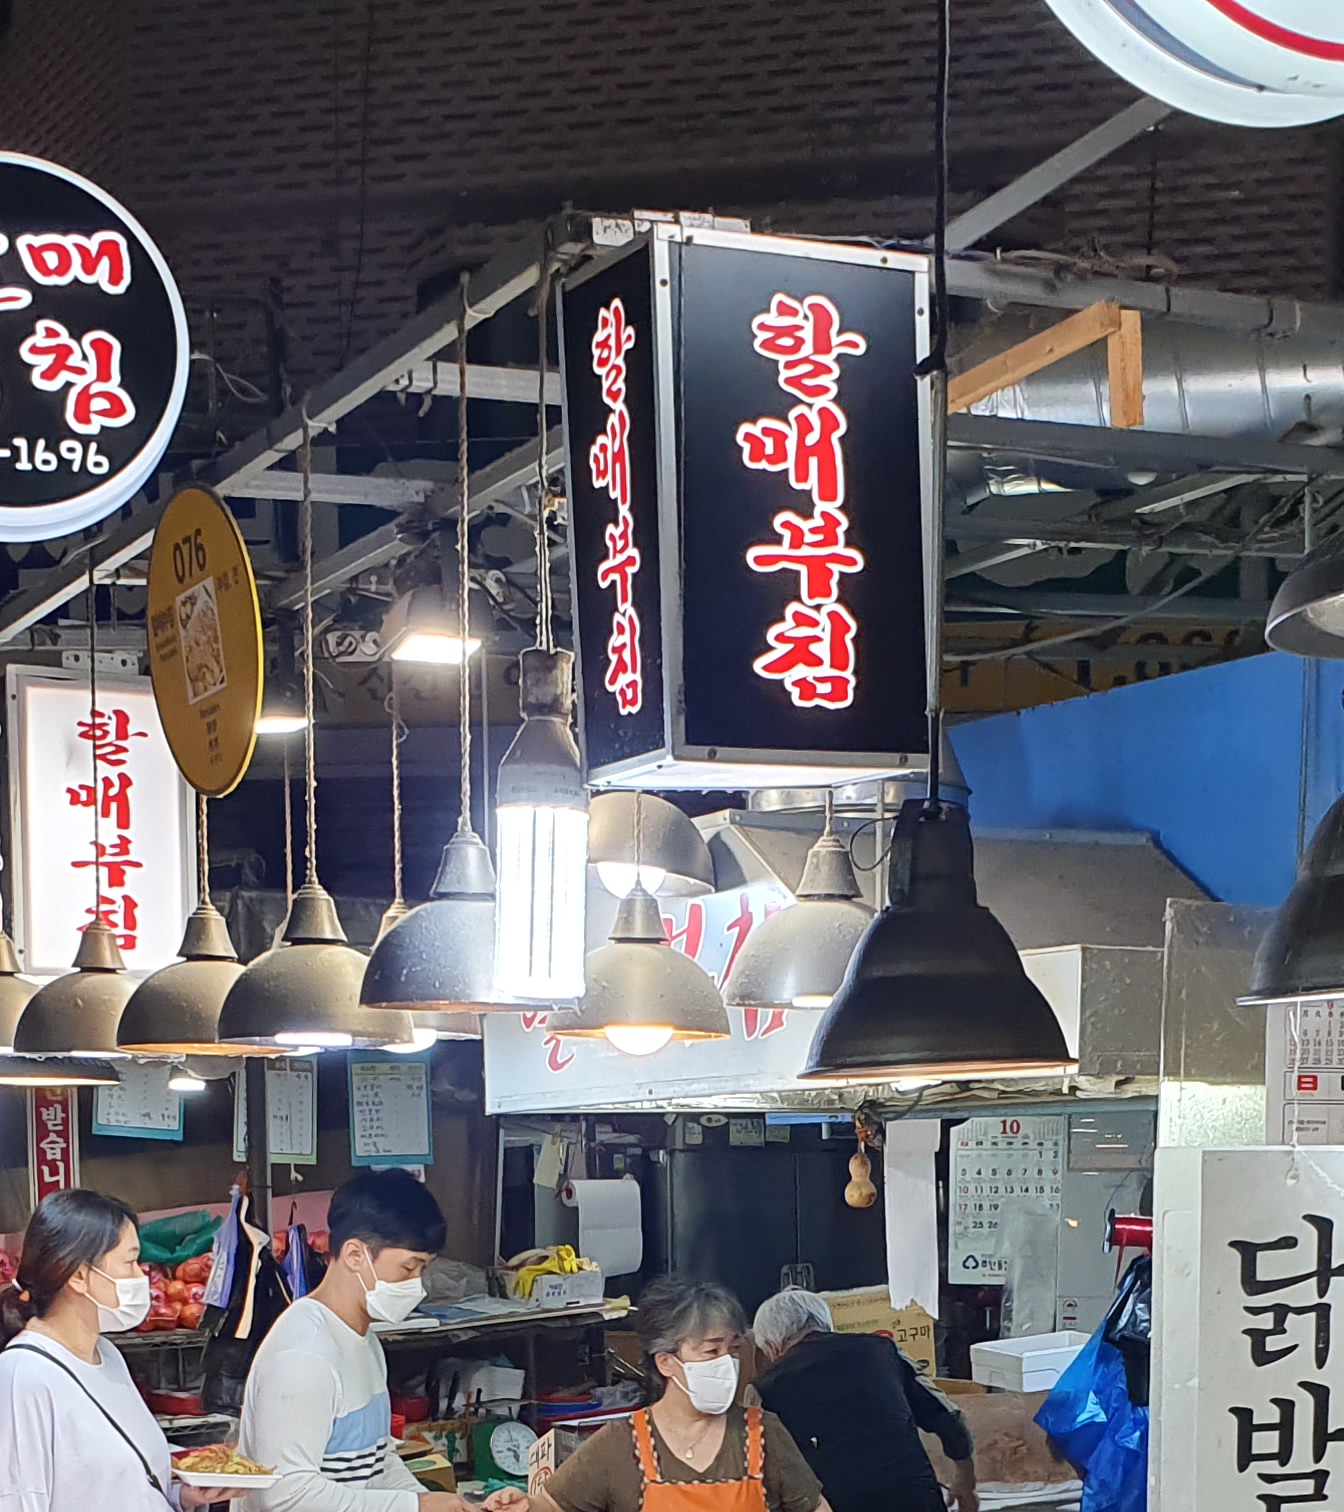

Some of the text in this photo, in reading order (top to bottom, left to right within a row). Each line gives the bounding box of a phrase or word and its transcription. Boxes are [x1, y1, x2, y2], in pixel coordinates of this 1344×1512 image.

[590, 298, 642, 715] 할매부침
[736, 292, 866, 710] 할매부침
[172, 527, 207, 585] 076
[65, 709, 149, 951] 할매부침
[999, 1119, 1021, 1135] 10
[958, 1185, 1060, 1195] 10 11 12 13 14 15 16
[958, 1203, 968, 1212] 17
[973, 1203, 984, 1212] 18
[988, 1203, 1000, 1212] 19
[972, 1221, 984, 1230] 25
[896, 1324, 931, 1343] 고구마
